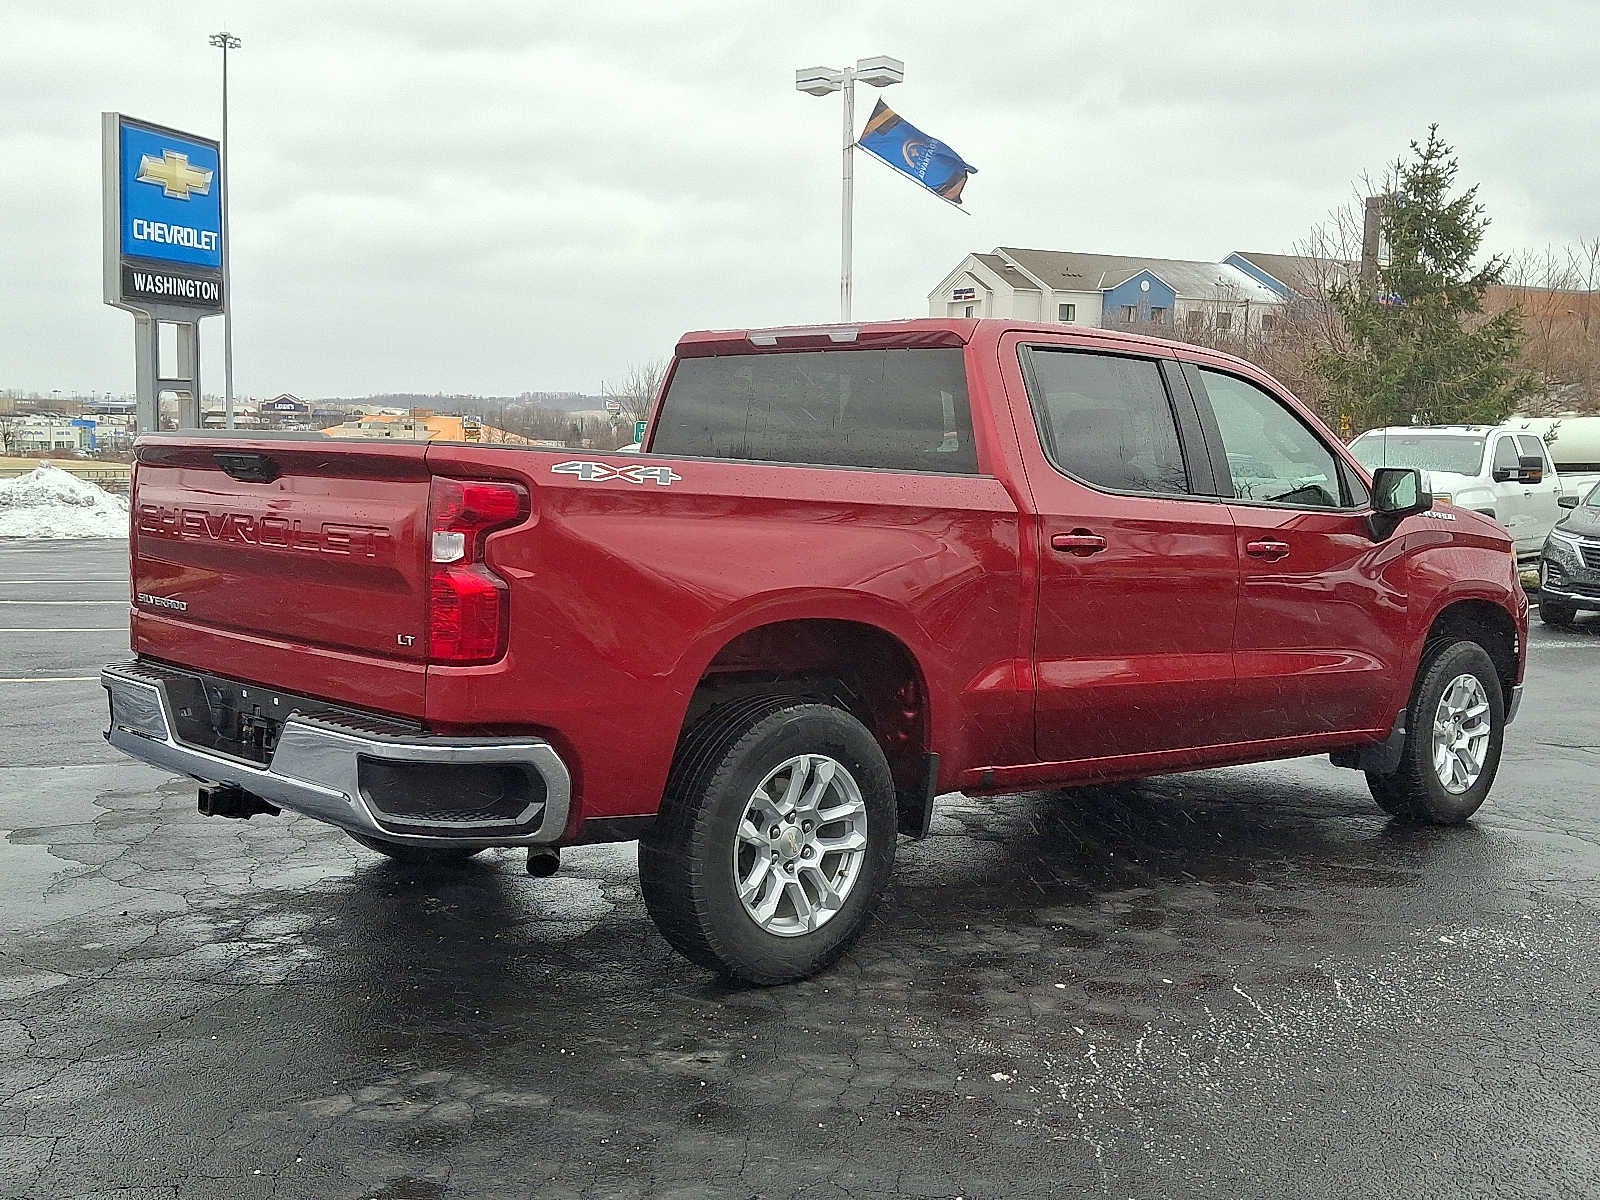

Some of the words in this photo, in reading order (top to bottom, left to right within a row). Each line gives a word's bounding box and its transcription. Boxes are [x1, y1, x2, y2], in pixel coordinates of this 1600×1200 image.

[133, 218, 218, 251] CHEVROLET
[133, 272, 219, 300] WASHINGTON
[139, 504, 391, 558] CHEVROLET
[138, 592, 187, 611] SILVERADO
[397, 634, 416, 646] LT
